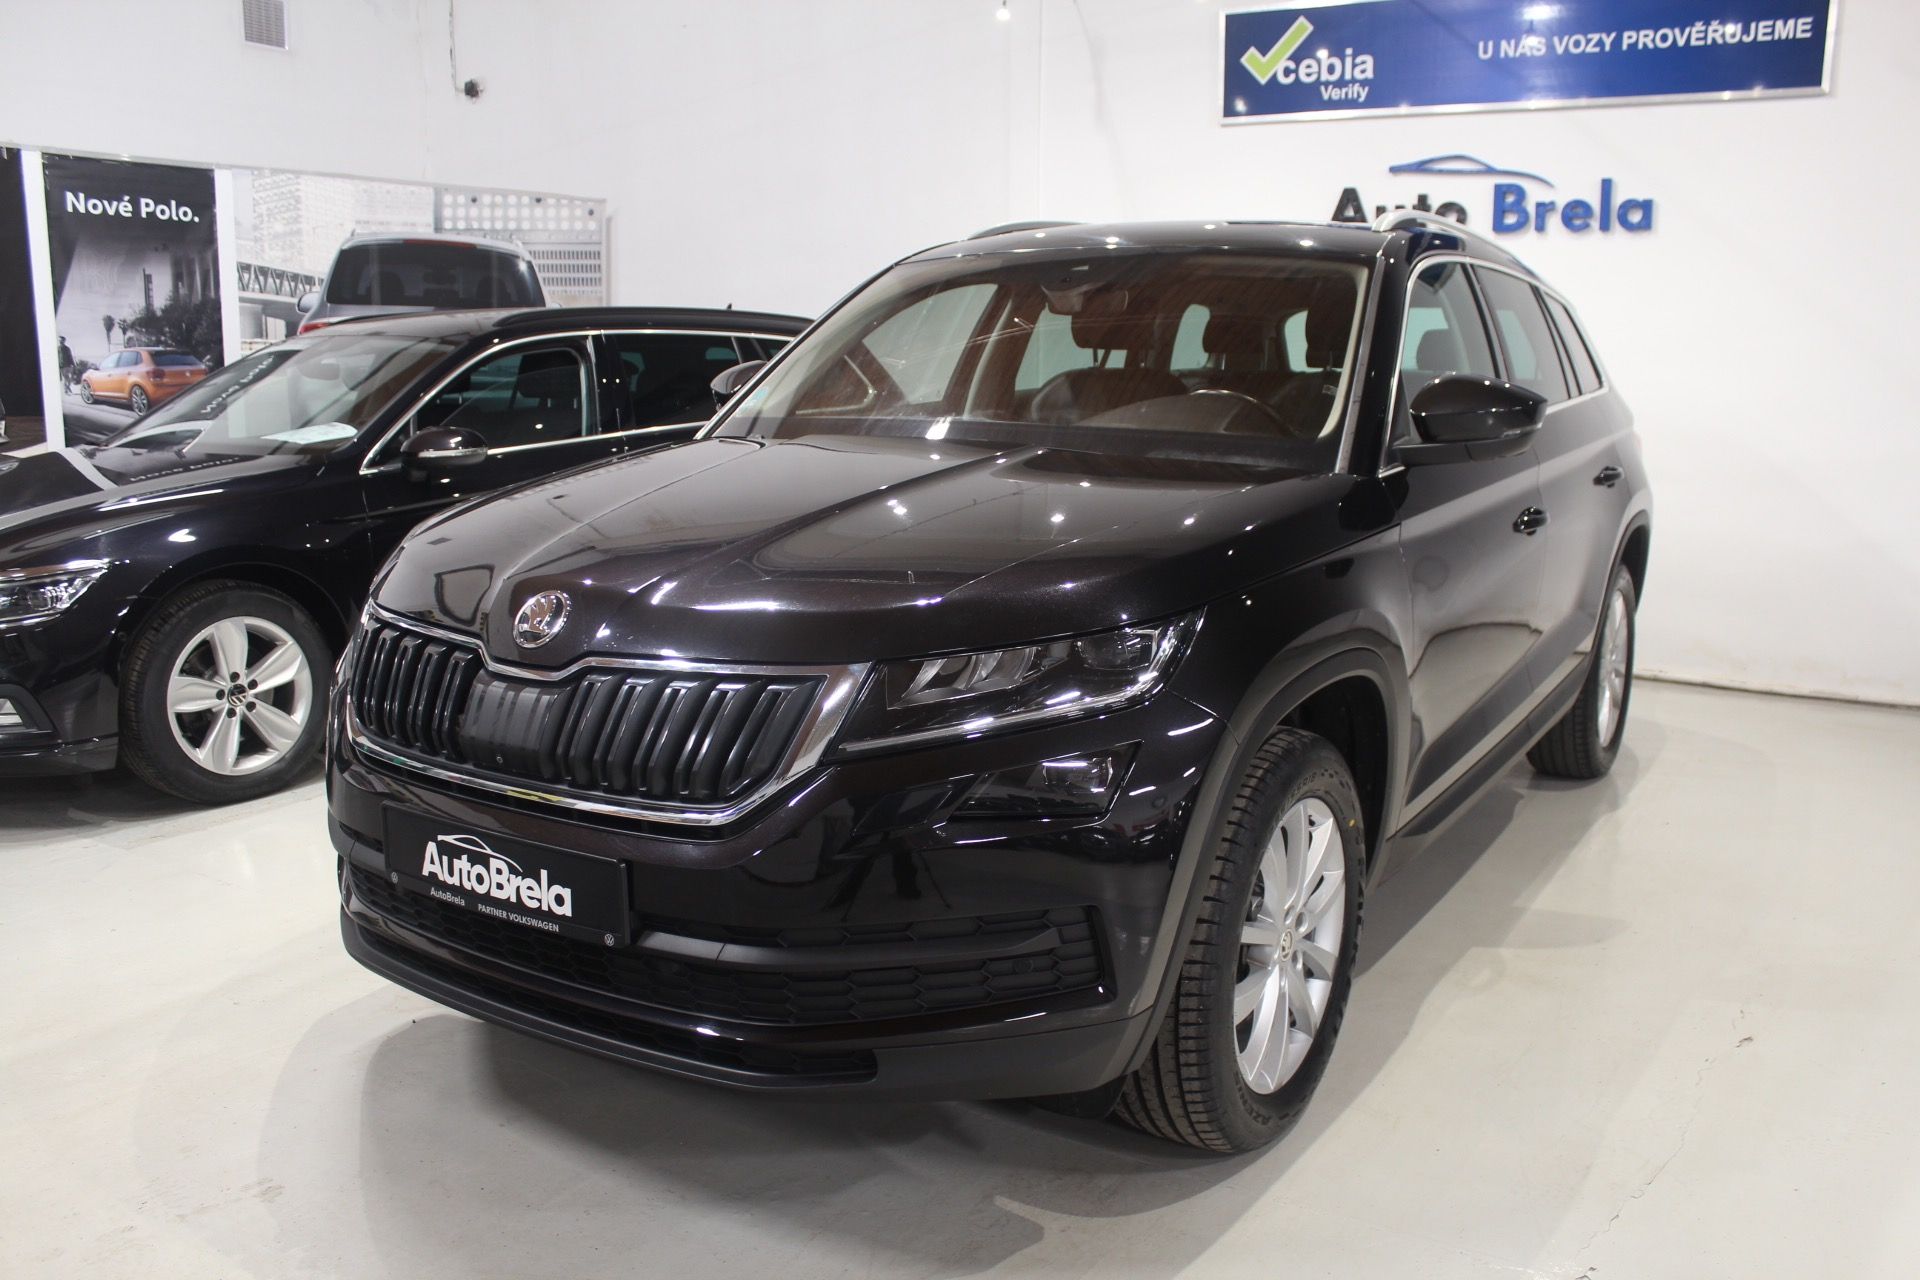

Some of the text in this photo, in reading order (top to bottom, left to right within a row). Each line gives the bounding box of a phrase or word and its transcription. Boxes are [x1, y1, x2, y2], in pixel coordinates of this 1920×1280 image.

[1477, 41, 1493, 60] U
[1553, 32, 1617, 56] VOZY
[1276, 48, 1374, 84] cebia
[1319, 83, 1370, 102] Verify
[64, 190, 200, 223] Nové Polo.
[1492, 178, 1654, 234] Brela
[422, 840, 573, 917] AutoBrela
[430, 886, 466, 906] AutoBrela
[477, 903, 560, 933] PARTNER VOLKSWAGEN
